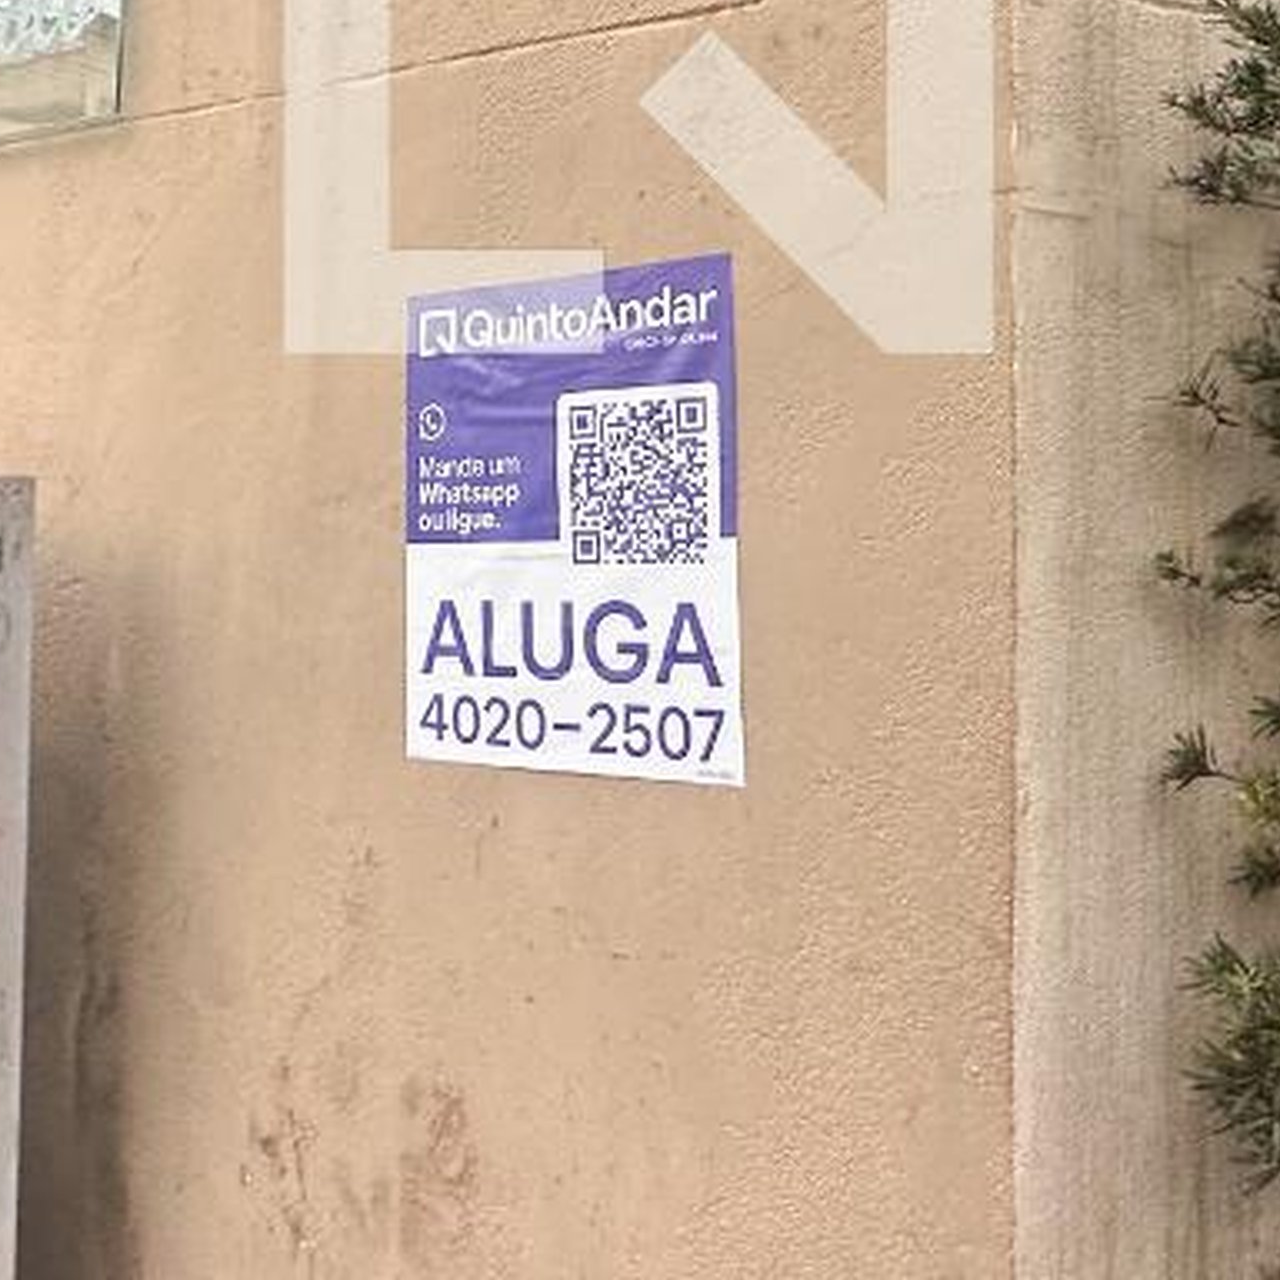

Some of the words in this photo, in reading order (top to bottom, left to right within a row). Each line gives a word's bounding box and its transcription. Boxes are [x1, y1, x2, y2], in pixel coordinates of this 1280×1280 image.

[463, 285, 718, 348] QuintoAndar
[419, 513, 444, 532] ou
[421, 599, 724, 687] ALUGA
[420, 693, 725, 763] 4020-2507
